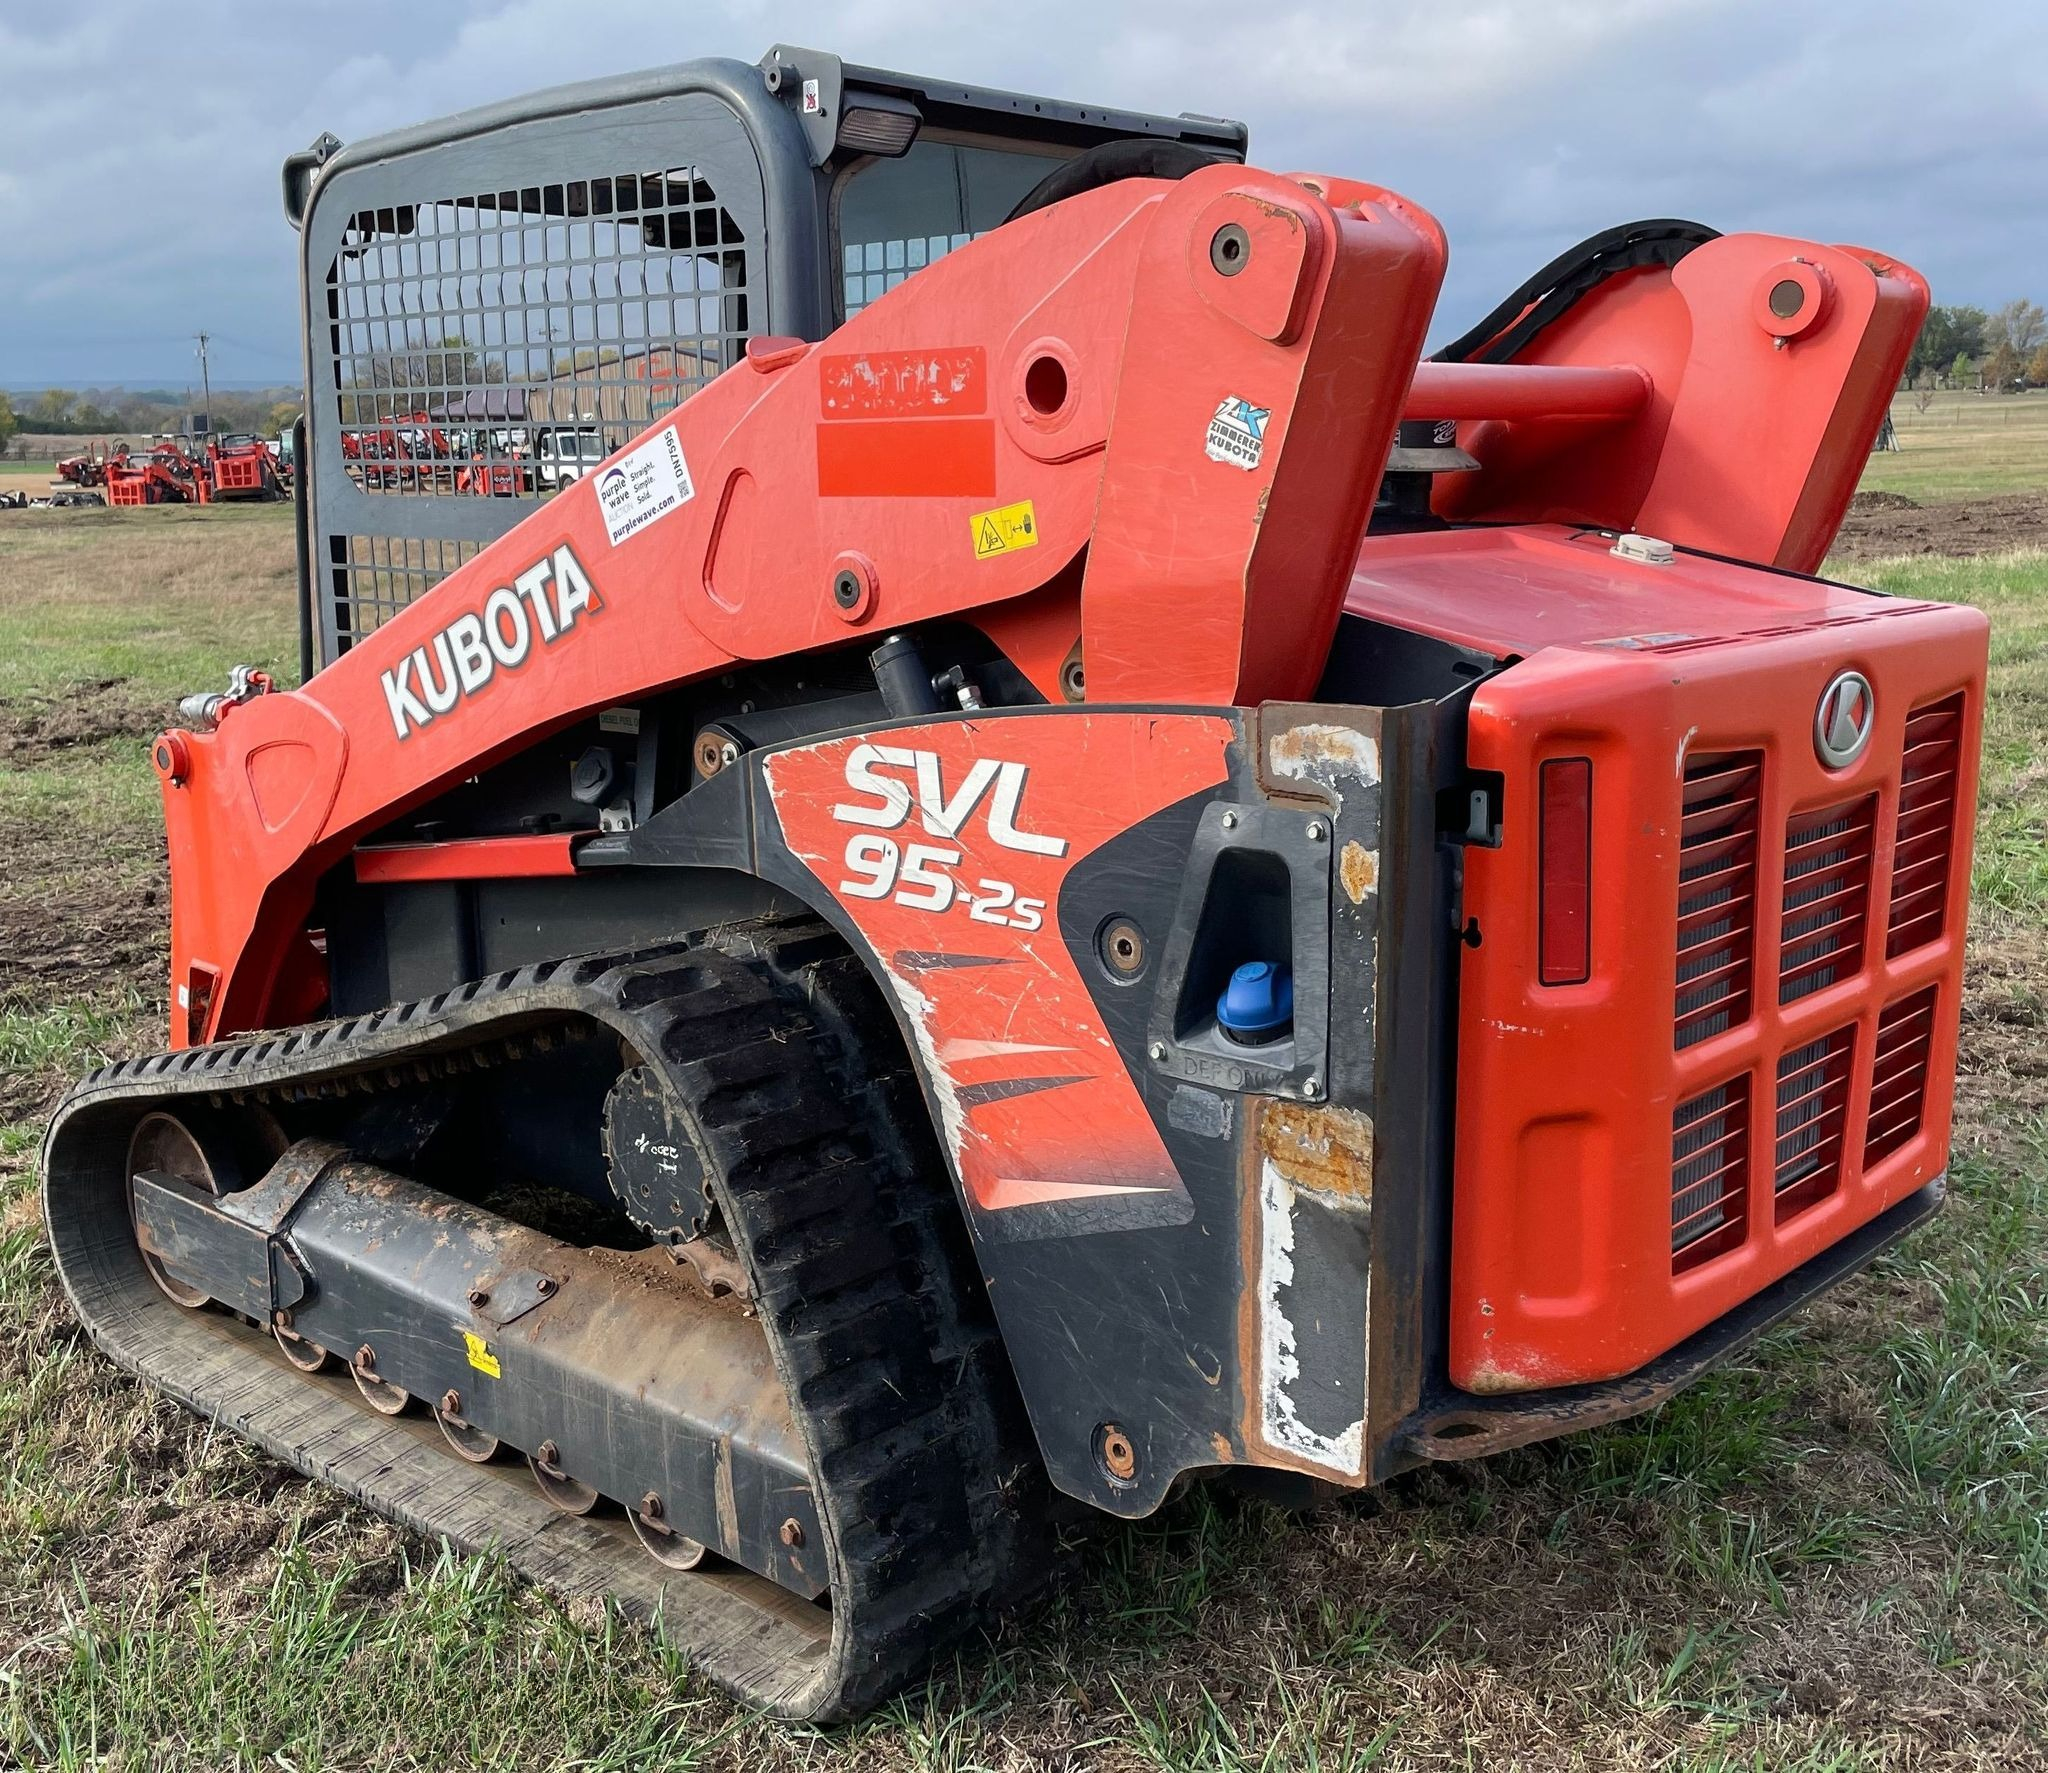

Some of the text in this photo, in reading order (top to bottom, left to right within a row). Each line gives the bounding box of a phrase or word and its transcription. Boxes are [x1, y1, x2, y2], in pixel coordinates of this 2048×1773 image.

[1208, 433, 1257, 463] KUBOTA
[1210, 421, 1261, 453] ZIMMERER
[664, 431, 684, 479] DN7595
[630, 461, 656, 482] Straight.
[633, 475, 656, 494] Simple.
[601, 477, 627, 503] purple
[608, 489, 630, 510] wave
[612, 494, 676, 542] purplewave.com
[380, 544, 603, 741] KUBOTA
[833, 743, 1070, 859] SVL
